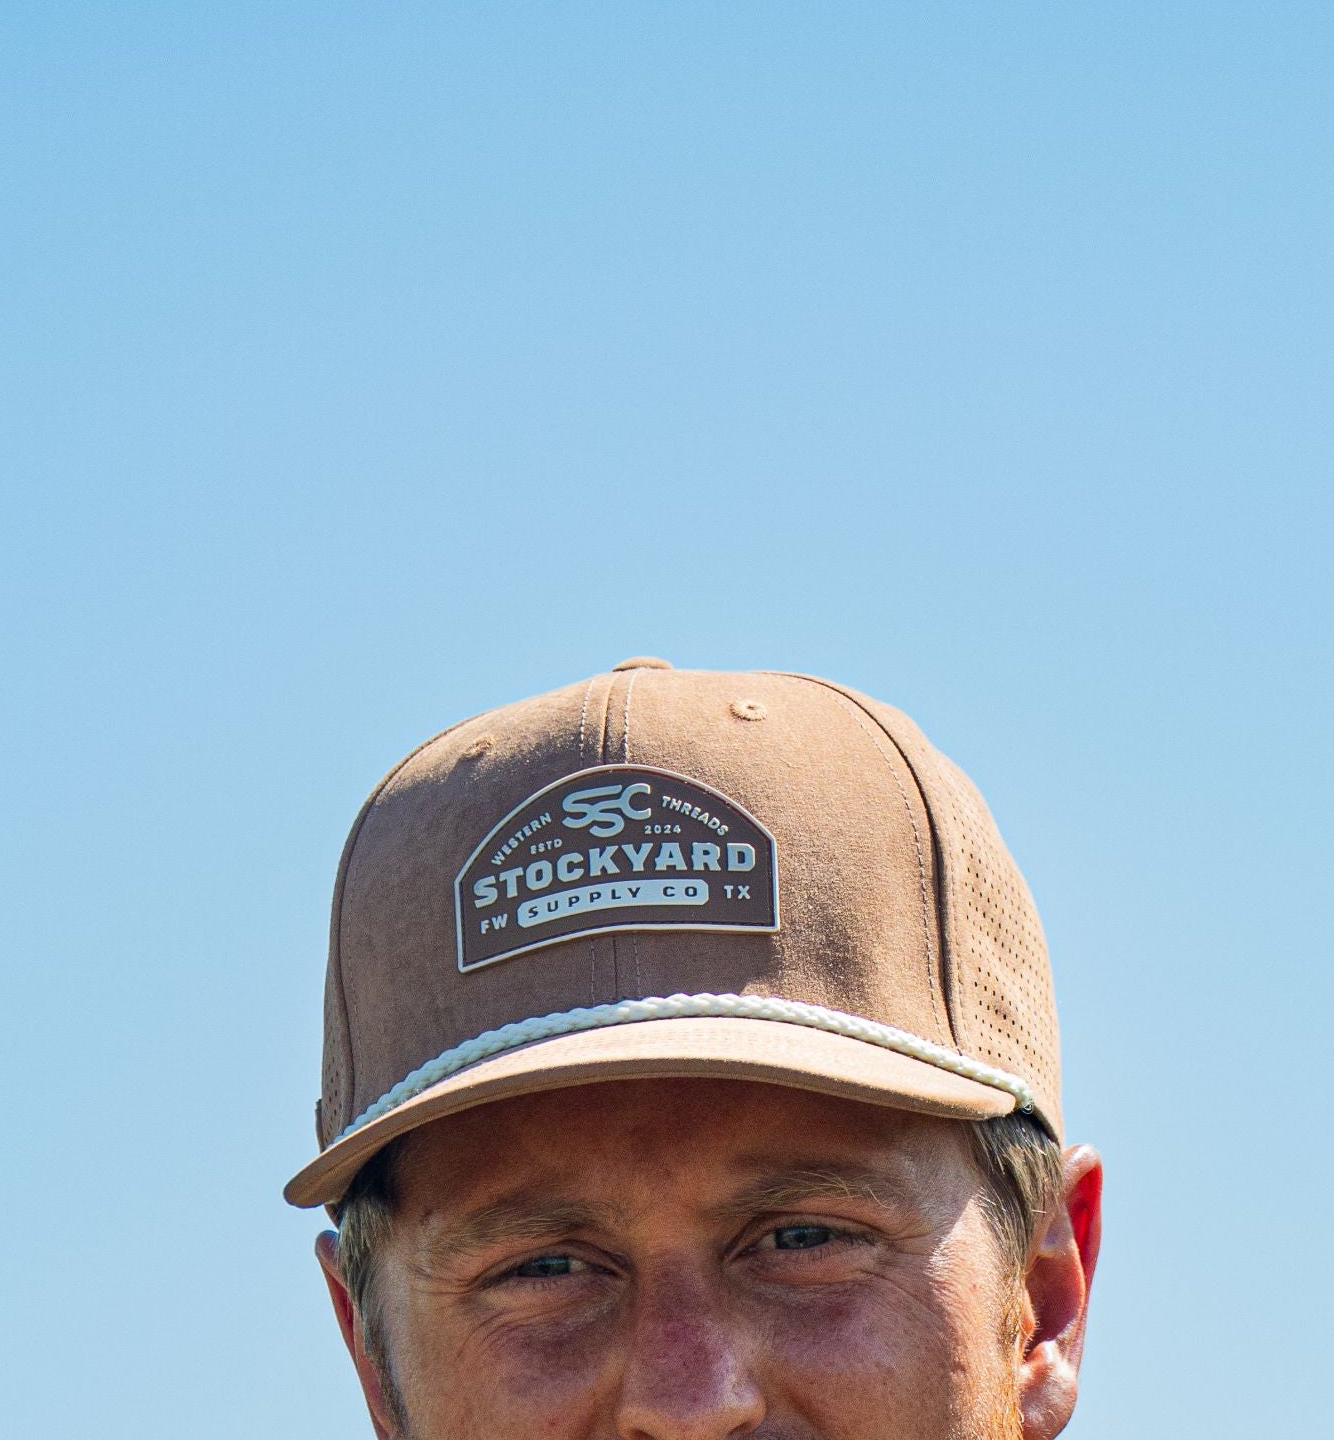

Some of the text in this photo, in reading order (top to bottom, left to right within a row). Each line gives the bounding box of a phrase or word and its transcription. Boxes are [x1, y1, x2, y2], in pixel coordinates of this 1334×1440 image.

[562, 783, 651, 838] SSC
[491, 795, 729, 866] WESTERN THREADS
[530, 824, 682, 855] ESTD 2024
[473, 842, 756, 909] STOCKYARD
[724, 885, 751, 900] TX
[527, 885, 698, 919] SUPPLY CO
[480, 913, 508, 935] FW
